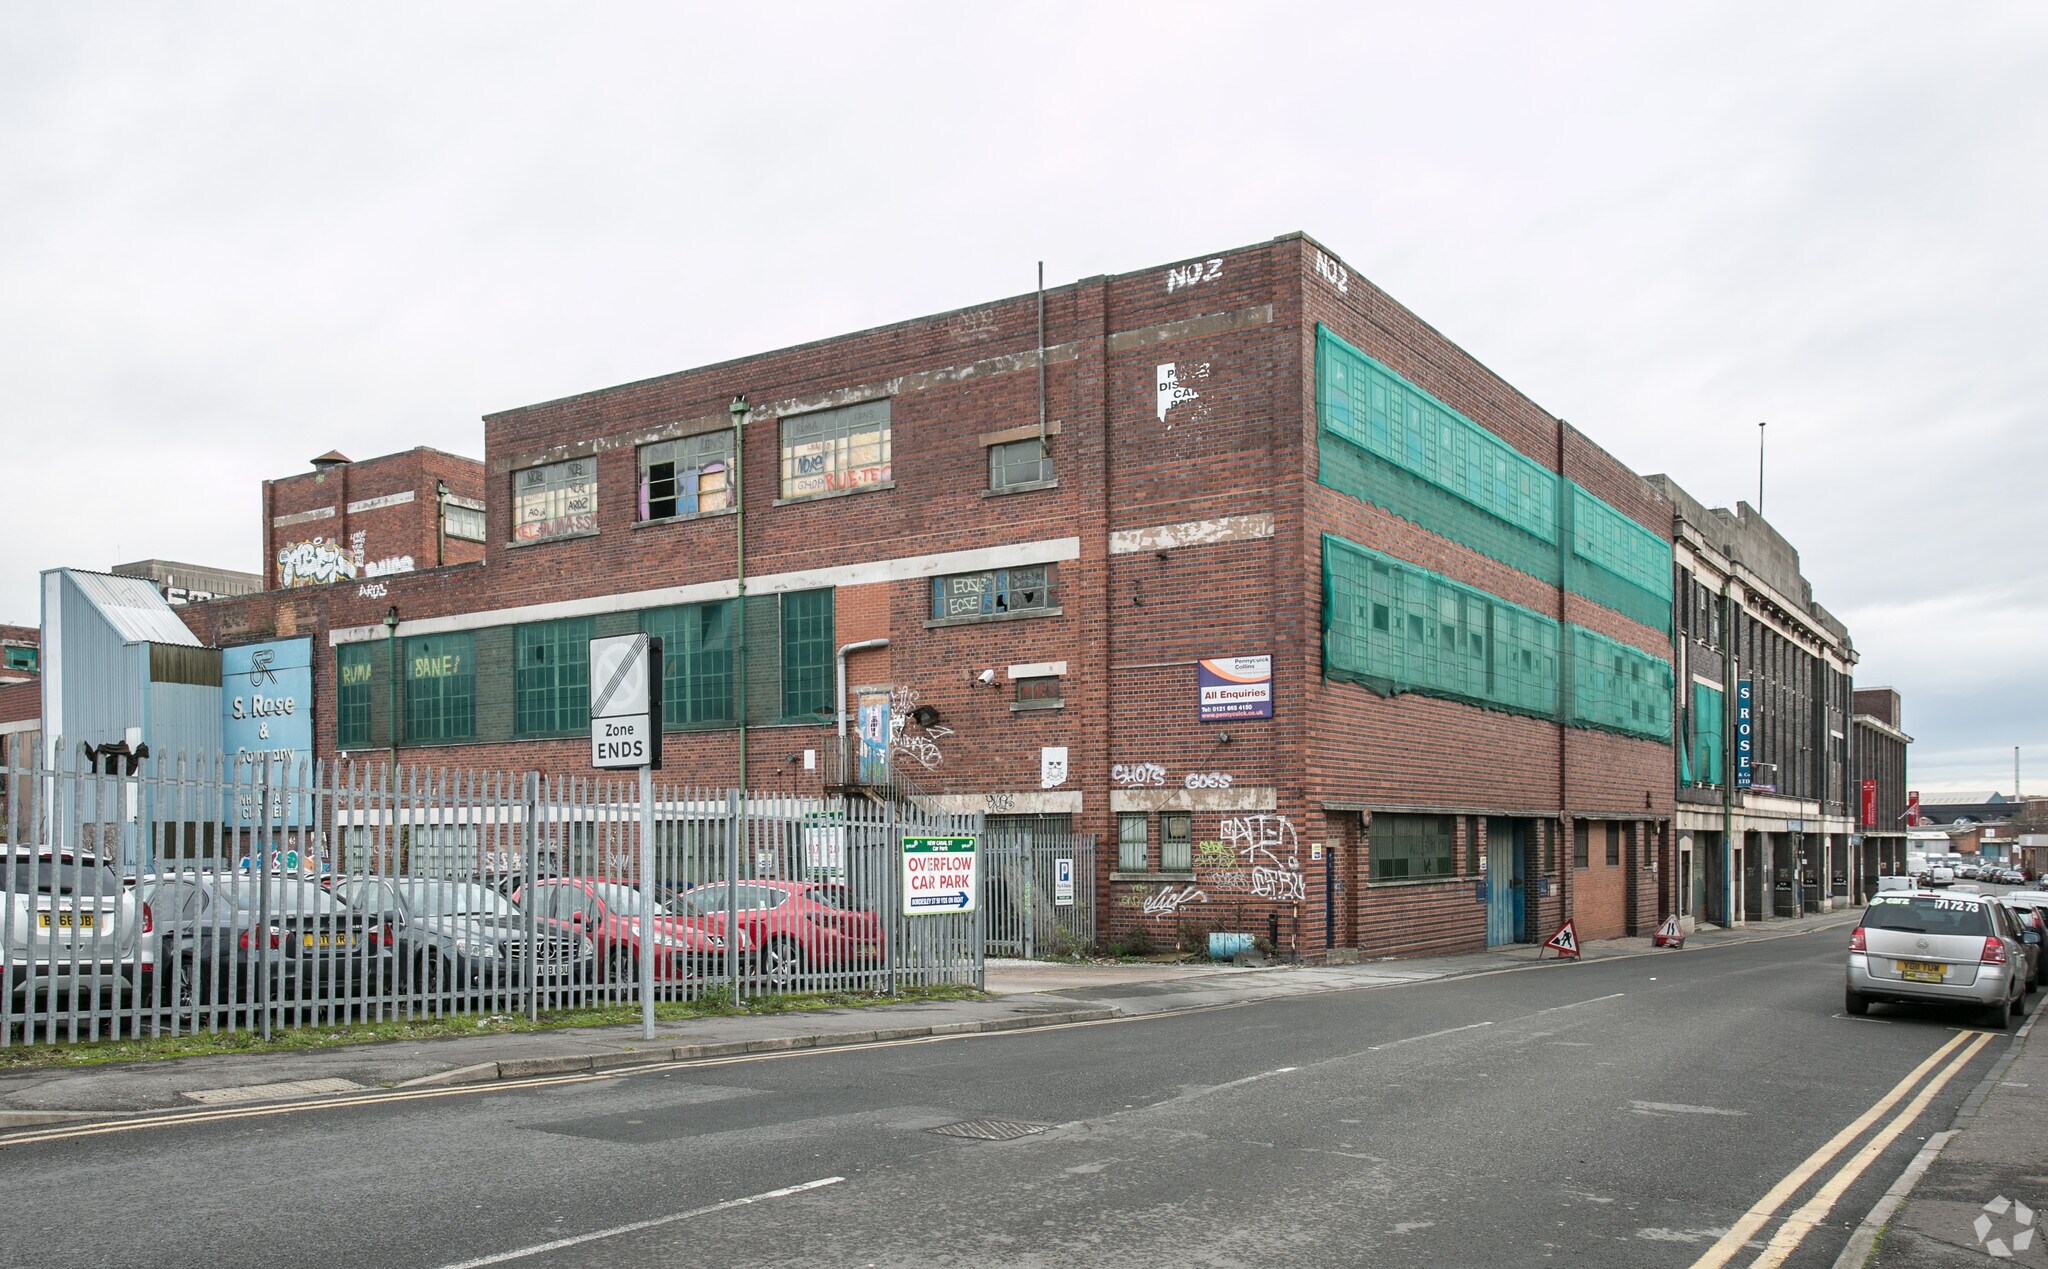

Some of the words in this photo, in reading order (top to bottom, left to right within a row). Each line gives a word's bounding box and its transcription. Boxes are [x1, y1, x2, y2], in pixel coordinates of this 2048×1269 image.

[1205, 691, 1217, 700] All
[1220, 688, 1266, 699] Enquiries
[1740, 687, 1750, 699] S
[232, 695, 247, 719] S.
[251, 693, 296, 717] Rose
[258, 721, 269, 739] &
[605, 723, 634, 737] Zone
[1739, 708, 1750, 768] ROSE
[238, 746, 295, 769] Comany
[598, 740, 643, 759] ENDS
[908, 856, 972, 872] OVERFLOW
[911, 875, 935, 890] CAR
[940, 874, 969, 889] PARK
[1950, 900, 1964, 911] 72
[1965, 902, 1979, 913] 73
